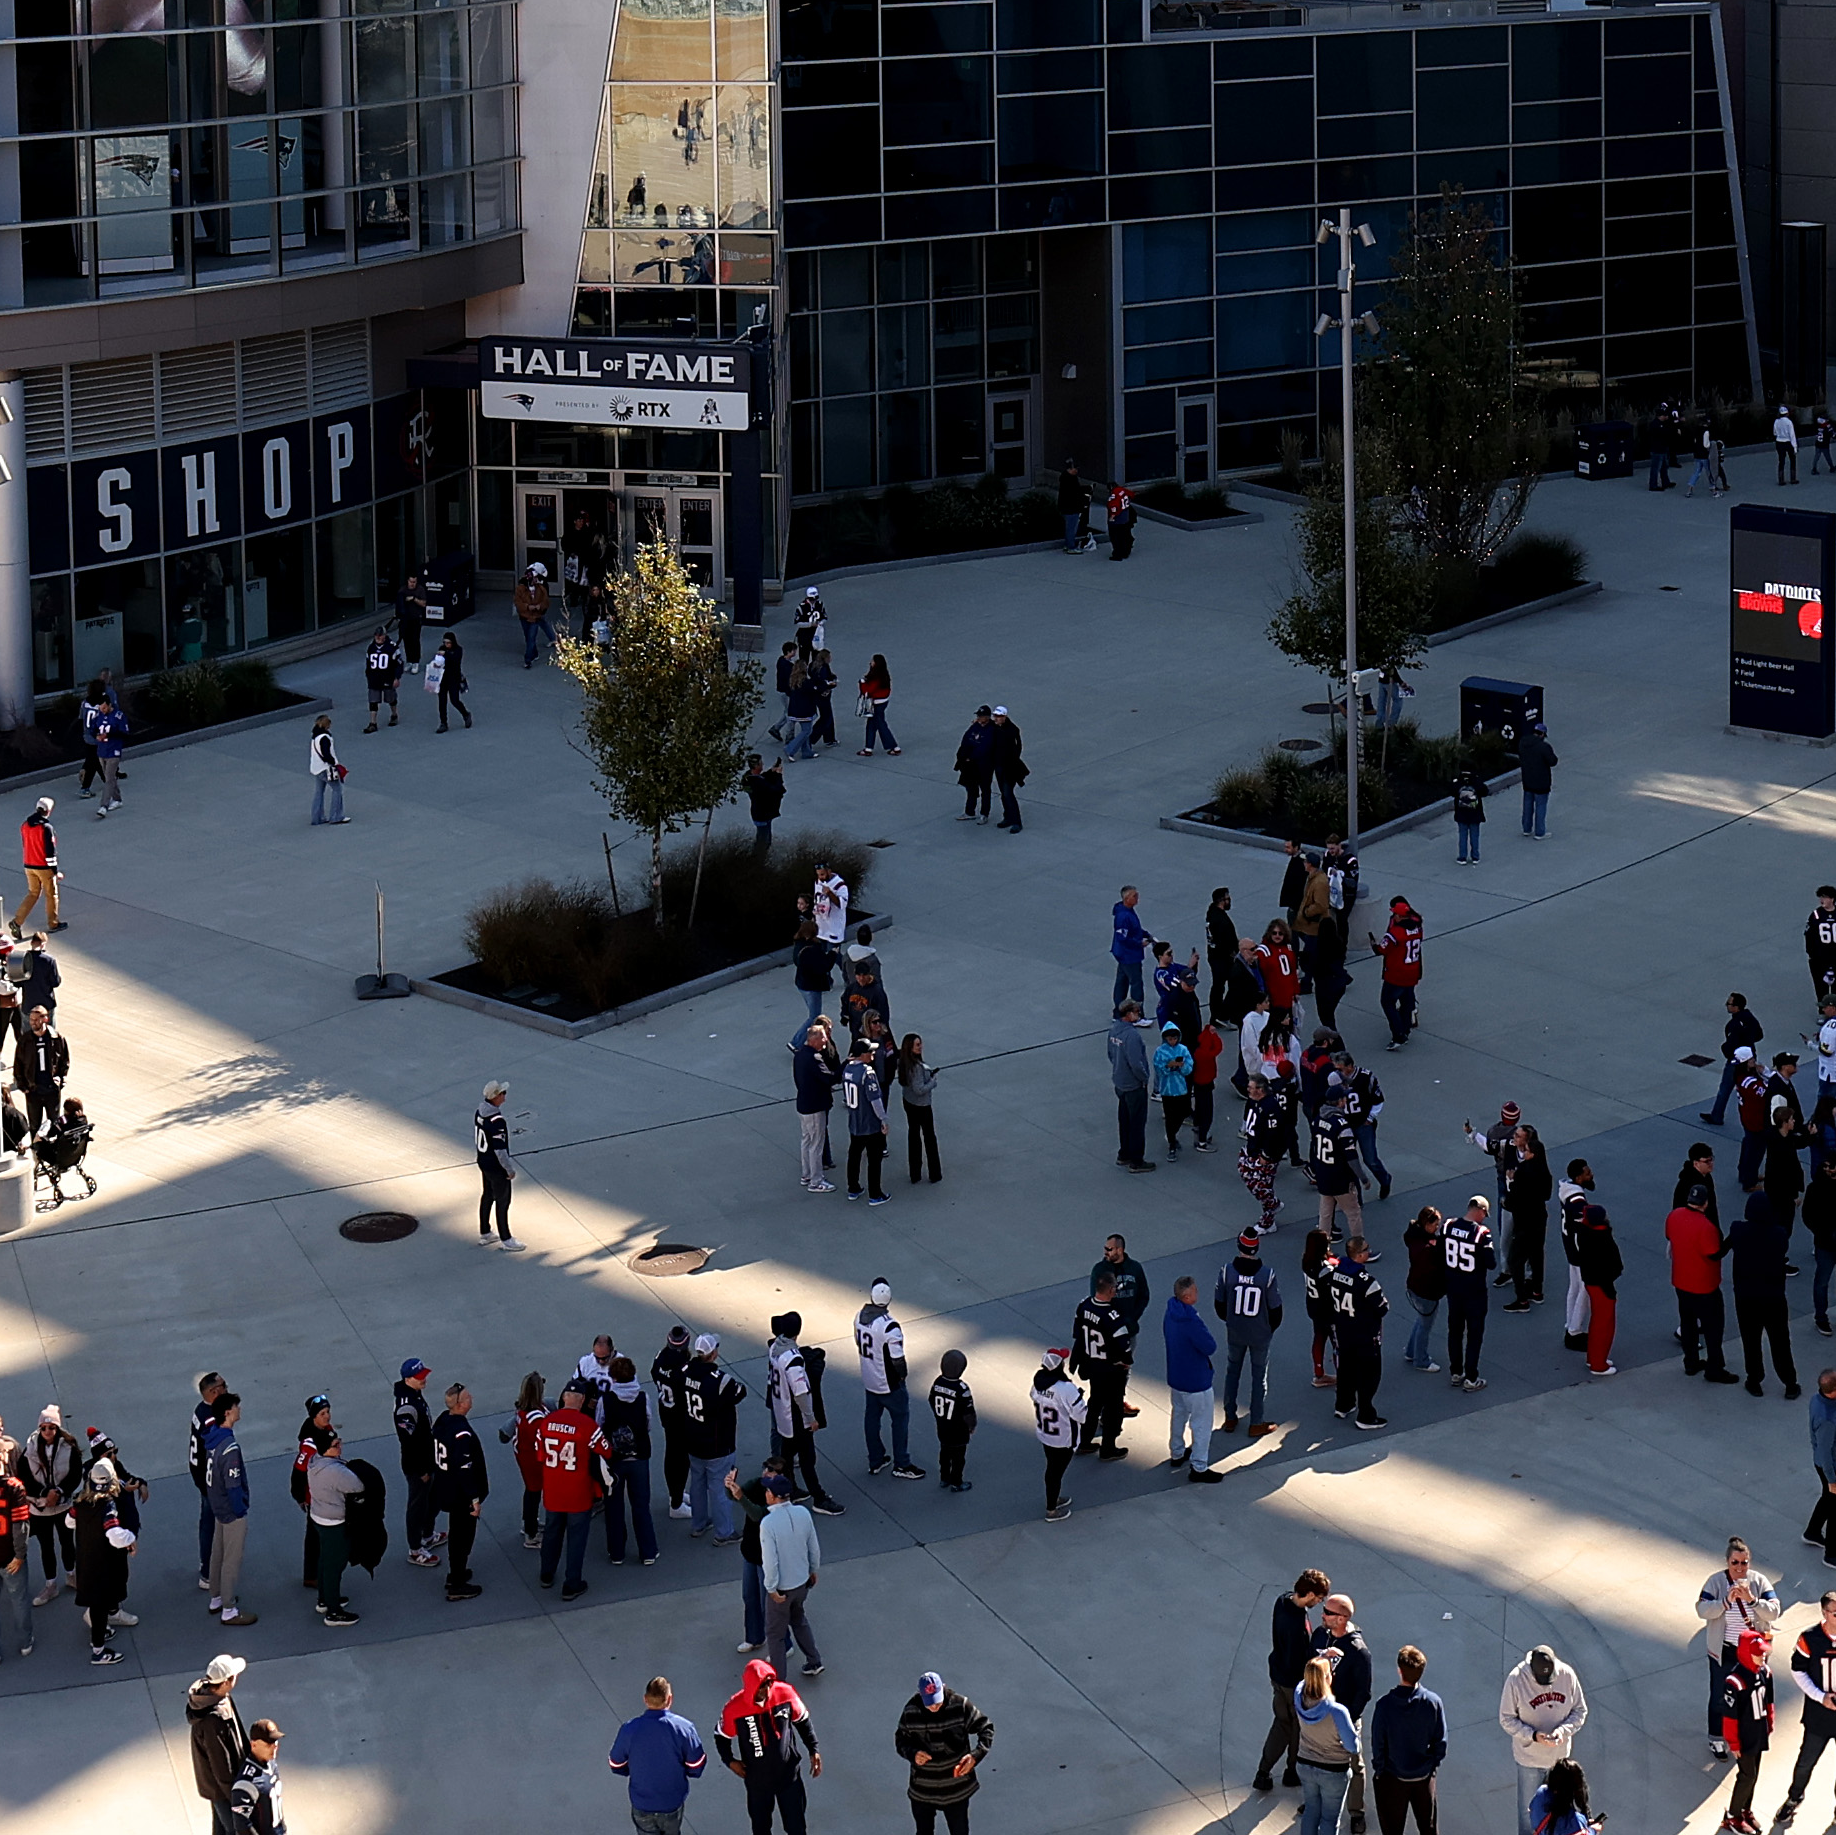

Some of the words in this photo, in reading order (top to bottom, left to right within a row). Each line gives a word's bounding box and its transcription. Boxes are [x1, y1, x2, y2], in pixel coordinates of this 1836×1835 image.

[494, 346, 602, 379] HALL
[603, 358, 623, 372] OF
[626, 352, 735, 384] FAME
[556, 401, 589, 409] PRESENTED
[638, 402, 671, 418] RTX
[98, 421, 354, 553] SHOP
[531, 495, 552, 508] EXIT
[637, 498, 664, 510] ENTER
[682, 500, 710, 512] ENTER
[370, 654, 388, 669] 50
[1741, 658, 1753, 666] Bud
[1753, 660, 1767, 668] Light
[1741, 669, 1755, 678] Field
[1740, 680, 1777, 691] Ticketmaster
[1778, 686, 1796, 695] Ramp
[1405, 938, 1422, 963] 12
[1279, 954, 1290, 976] 0
[37, 1048, 46, 1071] 1
[844, 1082, 859, 1109] 10
[1315, 1134, 1334, 1165] 12
[1451, 1228, 1470, 1239] HENRY
[1445, 1238, 1476, 1272] 85
[1239, 1274, 1255, 1284] MAYE
[1234, 1286, 1262, 1316] 10
[1331, 1287, 1355, 1318] 54
[1108, 1309, 1120, 1320] 12
[1082, 1325, 1107, 1359] 12
[685, 1391, 704, 1423] 12
[935, 1395, 955, 1420] 87
[547, 1422, 576, 1434] BRUSCHI
[1035, 1403, 1060, 1436] 12
[544, 1438, 576, 1470] 54
[1750, 1686, 1767, 1720] 10
[744, 1715, 765, 1758] PATRIOTS
[243, 1765, 256, 1777] 12
